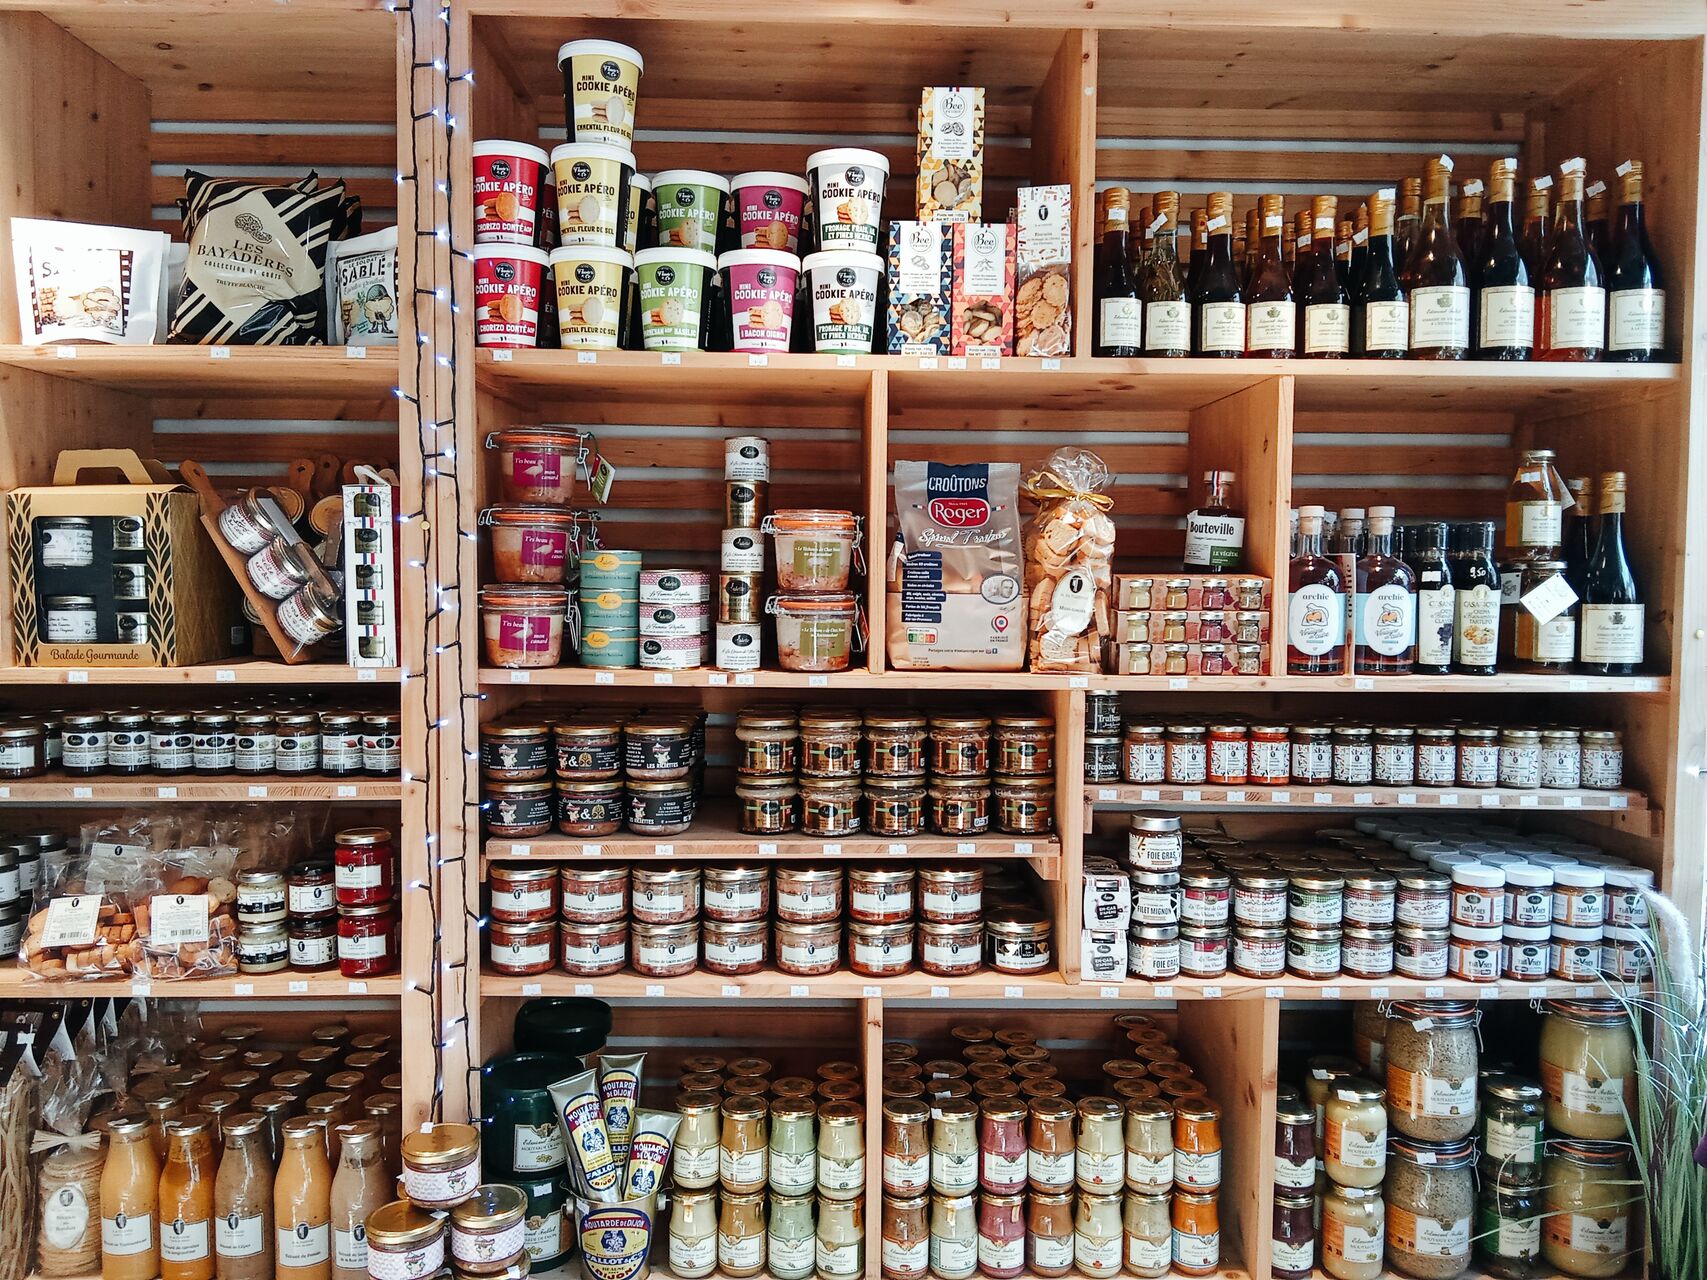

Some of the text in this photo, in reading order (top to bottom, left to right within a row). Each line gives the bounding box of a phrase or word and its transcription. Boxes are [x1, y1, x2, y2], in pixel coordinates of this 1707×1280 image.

[576, 82, 636, 102] COOKIE APÉRO
[944, 98, 963, 110] Bee
[604, 125, 620, 134] FLEUR
[474, 181, 534, 196] COOKIE APÉRO
[558, 182, 615, 196] COOKIE APÉRO
[822, 188, 880, 203] COOKIE APÉRO
[658, 205, 714, 221] COOKIE APÉRO
[742, 210, 799, 224] COOKIE APÉRO
[477, 223, 502, 232] CHORIZO
[912, 234, 930, 245] Bee
[976, 236, 995, 247] Bee
[233, 240, 264, 255] LES
[204, 260, 245, 273] COLLECTION
[476, 282, 536, 298] COOKIE APÉRO
[558, 284, 618, 298] COOKIE APÉRO
[640, 286, 698, 298] COOKIE APÉRO
[734, 288, 792, 303] COOKIE APÉRO
[816, 288, 874, 302] COOKIE APÉRO
[480, 324, 504, 334] CHORIZO
[745, 329, 764, 338] BACON
[928, 474, 987, 492] CROÛTONS
[934, 502, 986, 525] Roger
[1190, 521, 1234, 535] Bouteville
[50, 650, 138, 664] Balade Gourmande
[568, 756, 578, 768] &
[580, 808, 592, 820] &
[1147, 850, 1178, 860] FOIE GRAS
[1137, 905, 1173, 915] FILET MIGNON
[1152, 960, 1166, 968] FOIE
[602, 1081, 636, 1091] MOUTARDE
[614, 1088, 631, 1098] DIJON
[568, 1102, 600, 1122] MOUTARDE
[634, 1144, 668, 1156] MOUTARDE
[644, 1152, 662, 1163] DIJON
[586, 1164, 616, 1180] FALLOT
[584, 1220, 620, 1230] MOUTARDE
[627, 1219, 646, 1228] DIJON
[586, 1254, 622, 1264] FALLOT
[596, 1267, 633, 1279] DIJON
